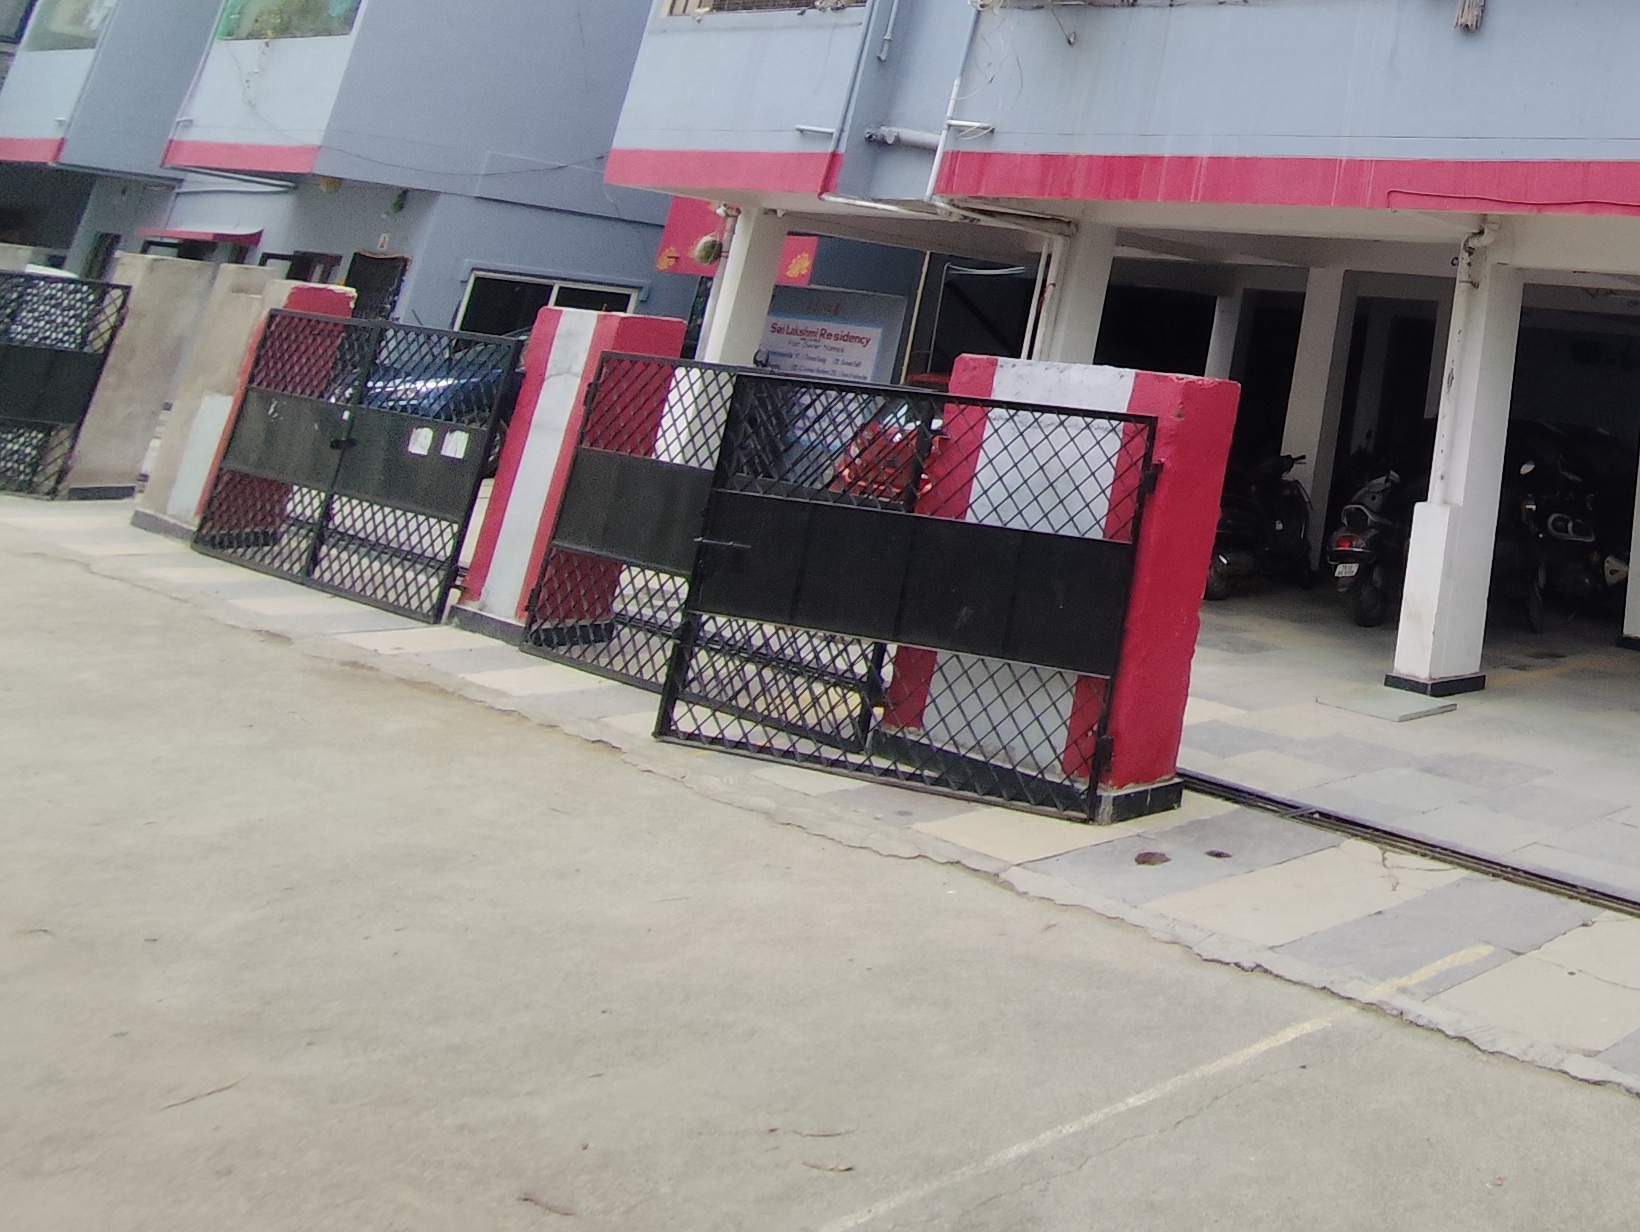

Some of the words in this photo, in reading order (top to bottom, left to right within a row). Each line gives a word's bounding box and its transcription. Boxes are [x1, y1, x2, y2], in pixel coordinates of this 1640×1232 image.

[770, 322, 785, 334] Sai
[786, 324, 819, 339] Lakshmi
[819, 328, 872, 347] Residency
